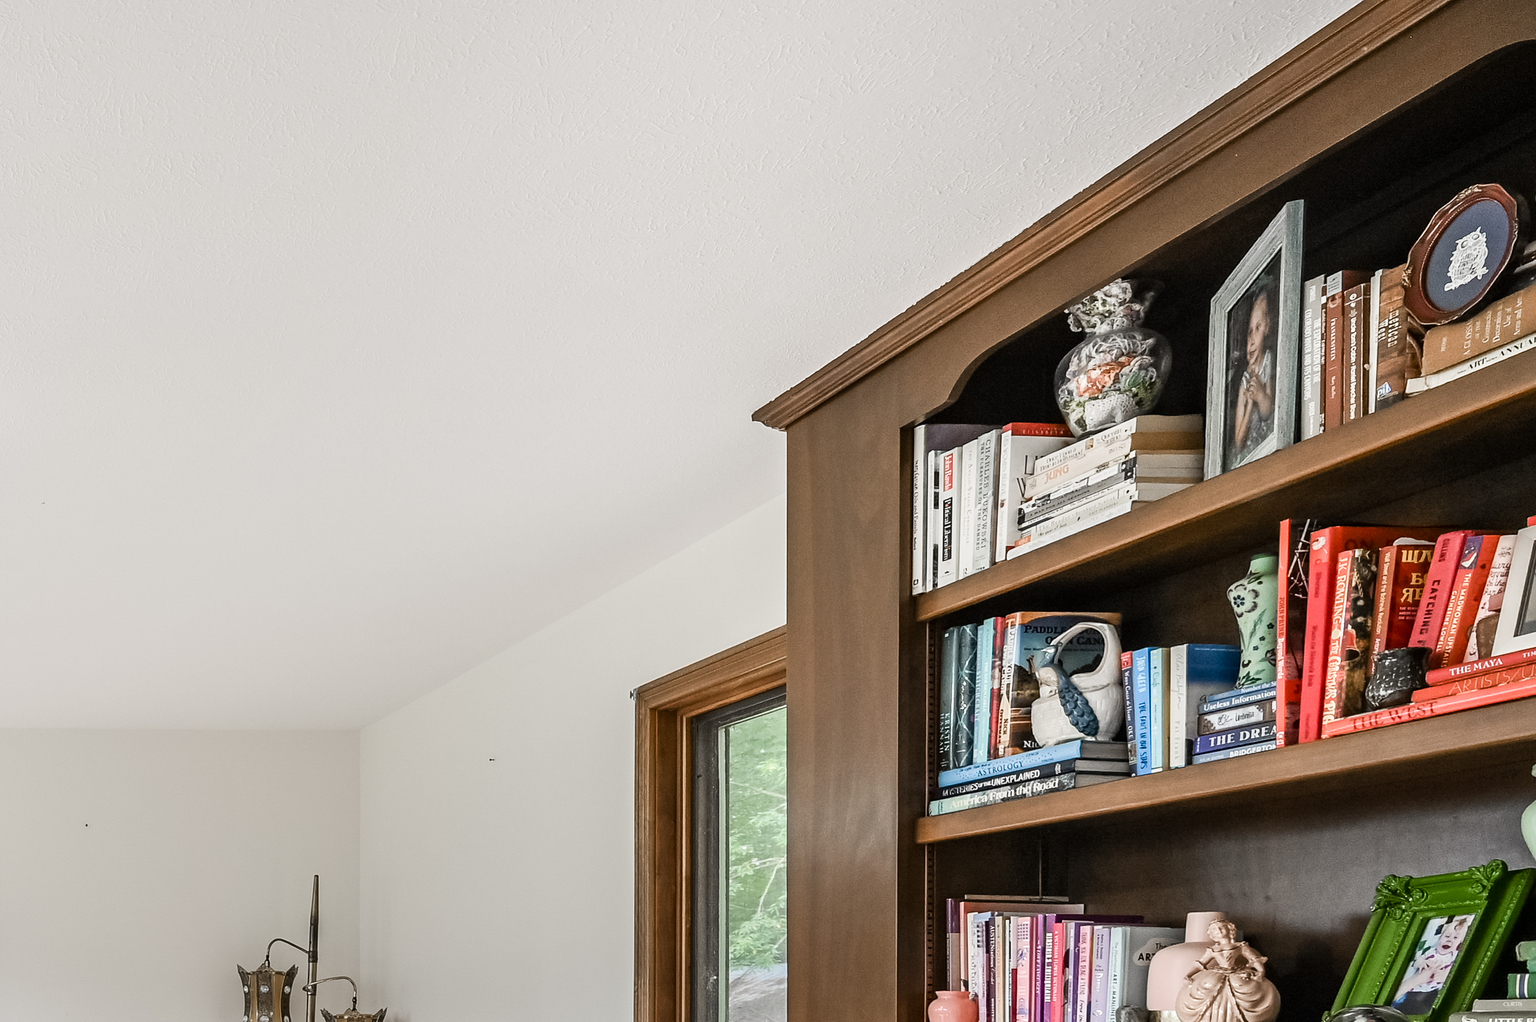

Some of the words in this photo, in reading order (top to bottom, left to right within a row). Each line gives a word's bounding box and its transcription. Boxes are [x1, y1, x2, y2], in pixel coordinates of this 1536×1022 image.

[1304, 309, 1312, 336] COLORADO
[1303, 376, 1311, 400] CANYONS
[983, 439, 991, 489] CHARLES
[1044, 464, 1070, 484] JUNG
[945, 498, 953, 525] Political
[981, 492, 989, 549] BUKOWSKI
[1462, 573, 1472, 587] THE
[1332, 576, 1346, 625] ROWLING
[1378, 593, 1386, 612] Bolshevik
[1419, 580, 1440, 635] CATCHING
[1443, 590, 1458, 625] CATHERINE
[1449, 589, 1466, 634] MADWOMAN
[1376, 612, 1385, 635] Revolution
[1436, 627, 1447, 652] LOWELL
[1440, 636, 1455, 668] UPSTAIRS
[1325, 656, 1341, 699] CHRISTMAS
[1449, 664, 1472, 677] THE
[1473, 658, 1503, 672] MAYA
[1137, 673, 1147, 693] GREEN
[1240, 684, 1261, 693] Number
[1139, 702, 1147, 713] THE
[1204, 700, 1230, 712] Useless
[1232, 690, 1277, 705] Information
[1322, 701, 1335, 725] PIG
[1350, 713, 1384, 731] THE
[1388, 701, 1439, 723] WEST
[1208, 733, 1236, 747] THE
[1239, 725, 1277, 742] DREA
[1140, 752, 1148, 770] STARS
[1230, 744, 1277, 758] BRIDGERTON
[977, 761, 1025, 777] ASTROLOGY
[942, 782, 979, 797] MYSTERIES
[991, 769, 1041, 787] UNEXPLAINED
[950, 794, 988, 809] America
[990, 788, 1015, 802] From
[1016, 782, 1032, 796] the
[1033, 778, 1060, 792] Road
